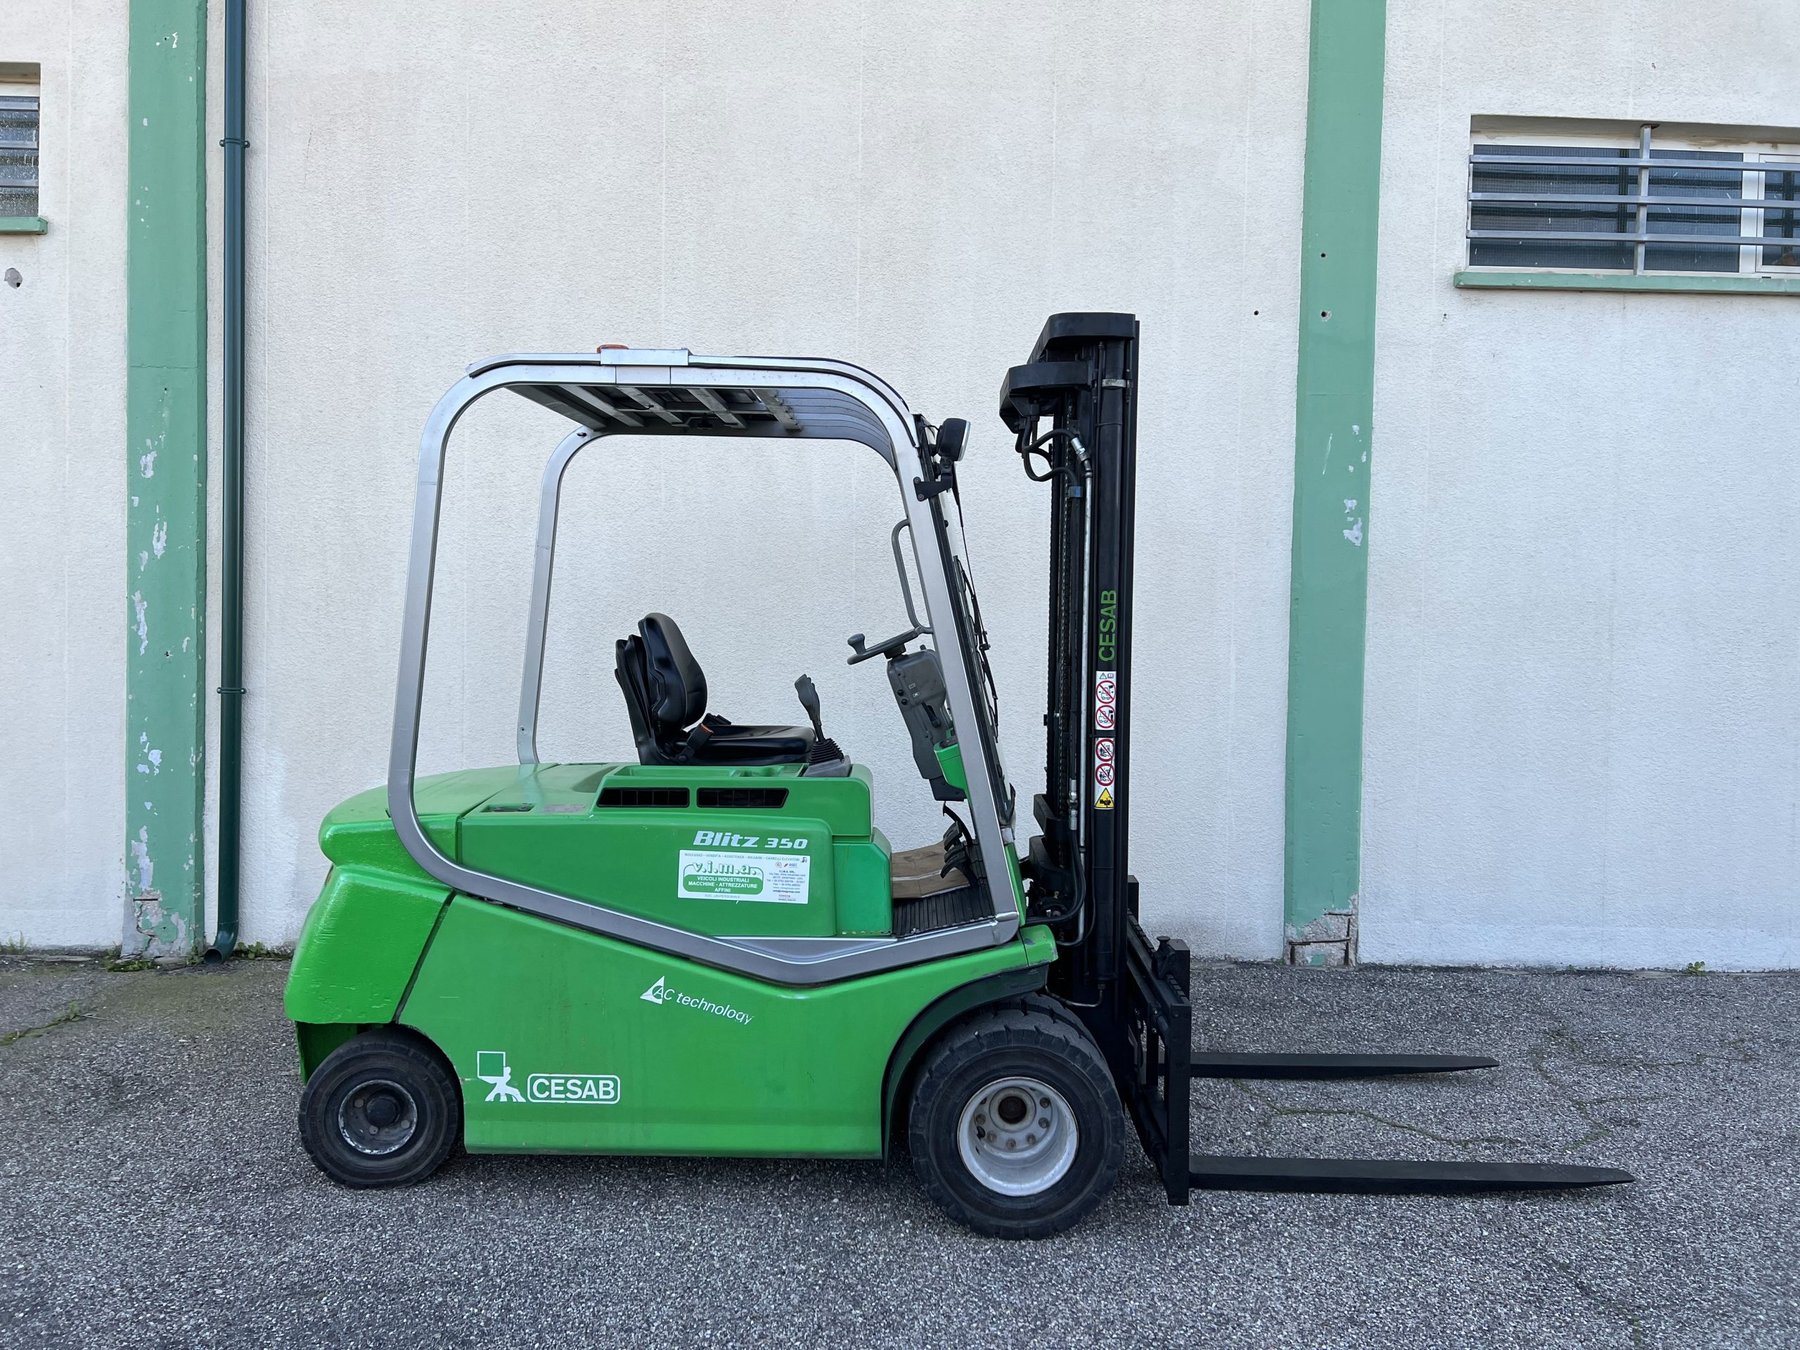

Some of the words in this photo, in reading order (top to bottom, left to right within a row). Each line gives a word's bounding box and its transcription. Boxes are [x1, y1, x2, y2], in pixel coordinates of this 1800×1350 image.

[1098, 590, 1116, 661] CESAB
[693, 830, 760, 848] Blitz
[765, 837, 808, 849] 350
[653, 984, 675, 1001] AC
[677, 992, 753, 1025] technology
[532, 1078, 615, 1100] CESAB
